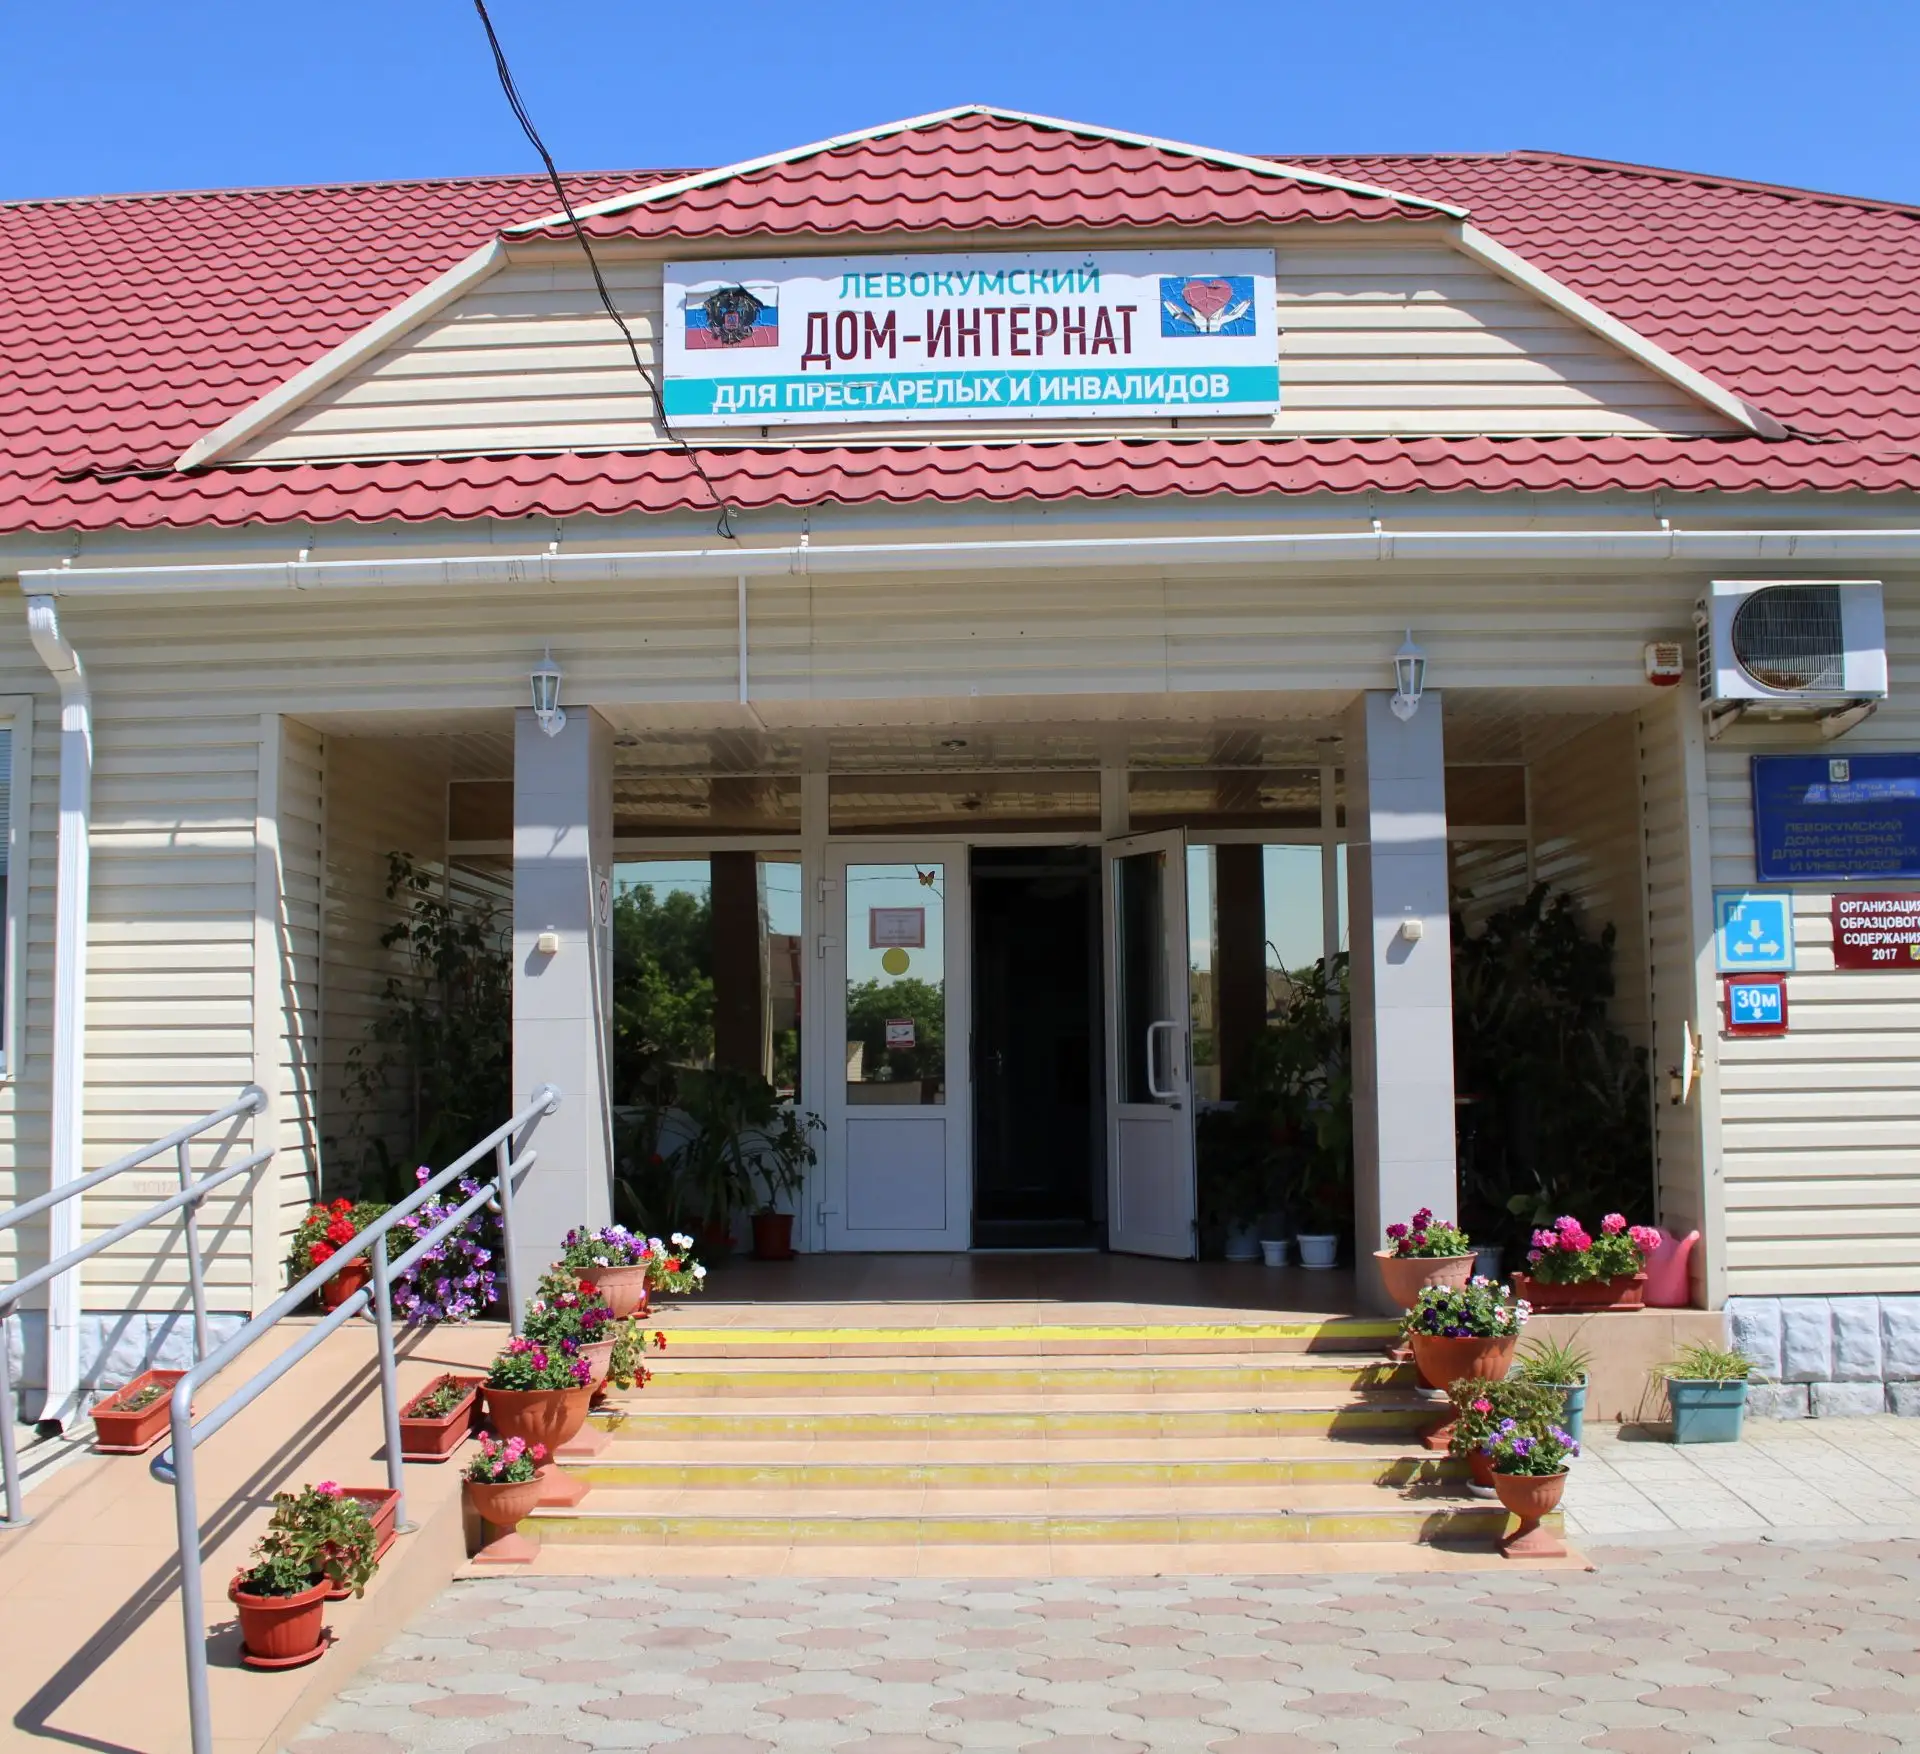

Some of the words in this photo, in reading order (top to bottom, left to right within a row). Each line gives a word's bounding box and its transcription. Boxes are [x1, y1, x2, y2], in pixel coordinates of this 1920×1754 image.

[839, 262, 1100, 299] ЛЕВОКУМСКИЙ
[800, 304, 1138, 371] ДОМ-ИНТЕРНАТ
[712, 384, 777, 415] ДЛЯ
[786, 376, 1000, 407] ПРЕСТАРЕЛЫХ
[1010, 378, 1031, 401] И
[1040, 374, 1230, 404] ИНВАЛИДОВ
[1785, 820, 1902, 833] ЛЕВОКУМСКИЙ
[1784, 833, 1904, 847] ДОМ-ИНТЕРНАТ
[1772, 848, 1804, 860] ДЛЯ
[1806, 846, 1918, 859] ПРЕСТАРЕЛЫХ
[1790, 861, 1802, 871] И
[1728, 905, 1746, 921] ПГ
[1872, 948, 1897, 960] 2017
